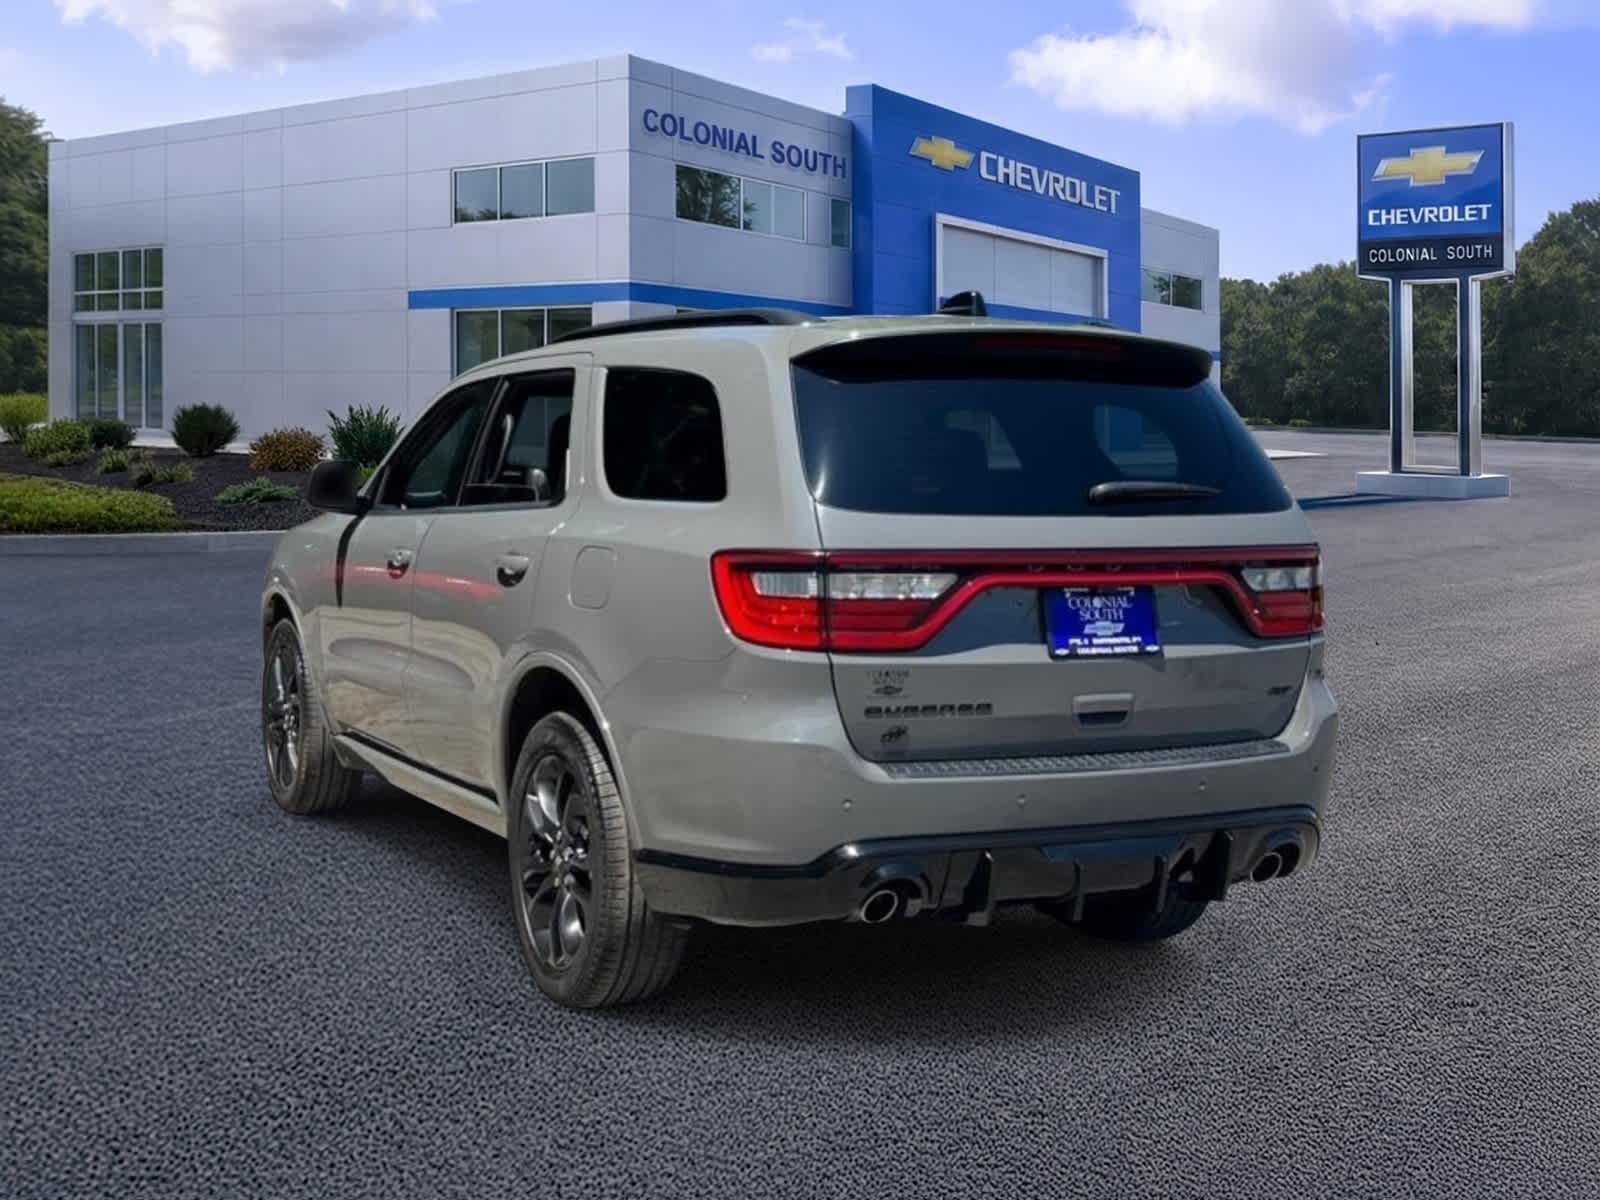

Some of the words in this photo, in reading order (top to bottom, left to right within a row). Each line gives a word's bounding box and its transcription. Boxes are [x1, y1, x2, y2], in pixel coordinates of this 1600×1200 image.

[643, 108, 765, 160] COLONIAL
[771, 140, 847, 179] SOUTH
[979, 150, 1121, 214] CHEVROLET
[1368, 203, 1492, 226] CHEVROLET
[1369, 248, 1437, 263] COLONIAL
[1447, 244, 1493, 259] SOUTH
[1080, 608, 1124, 621] SOUTH
